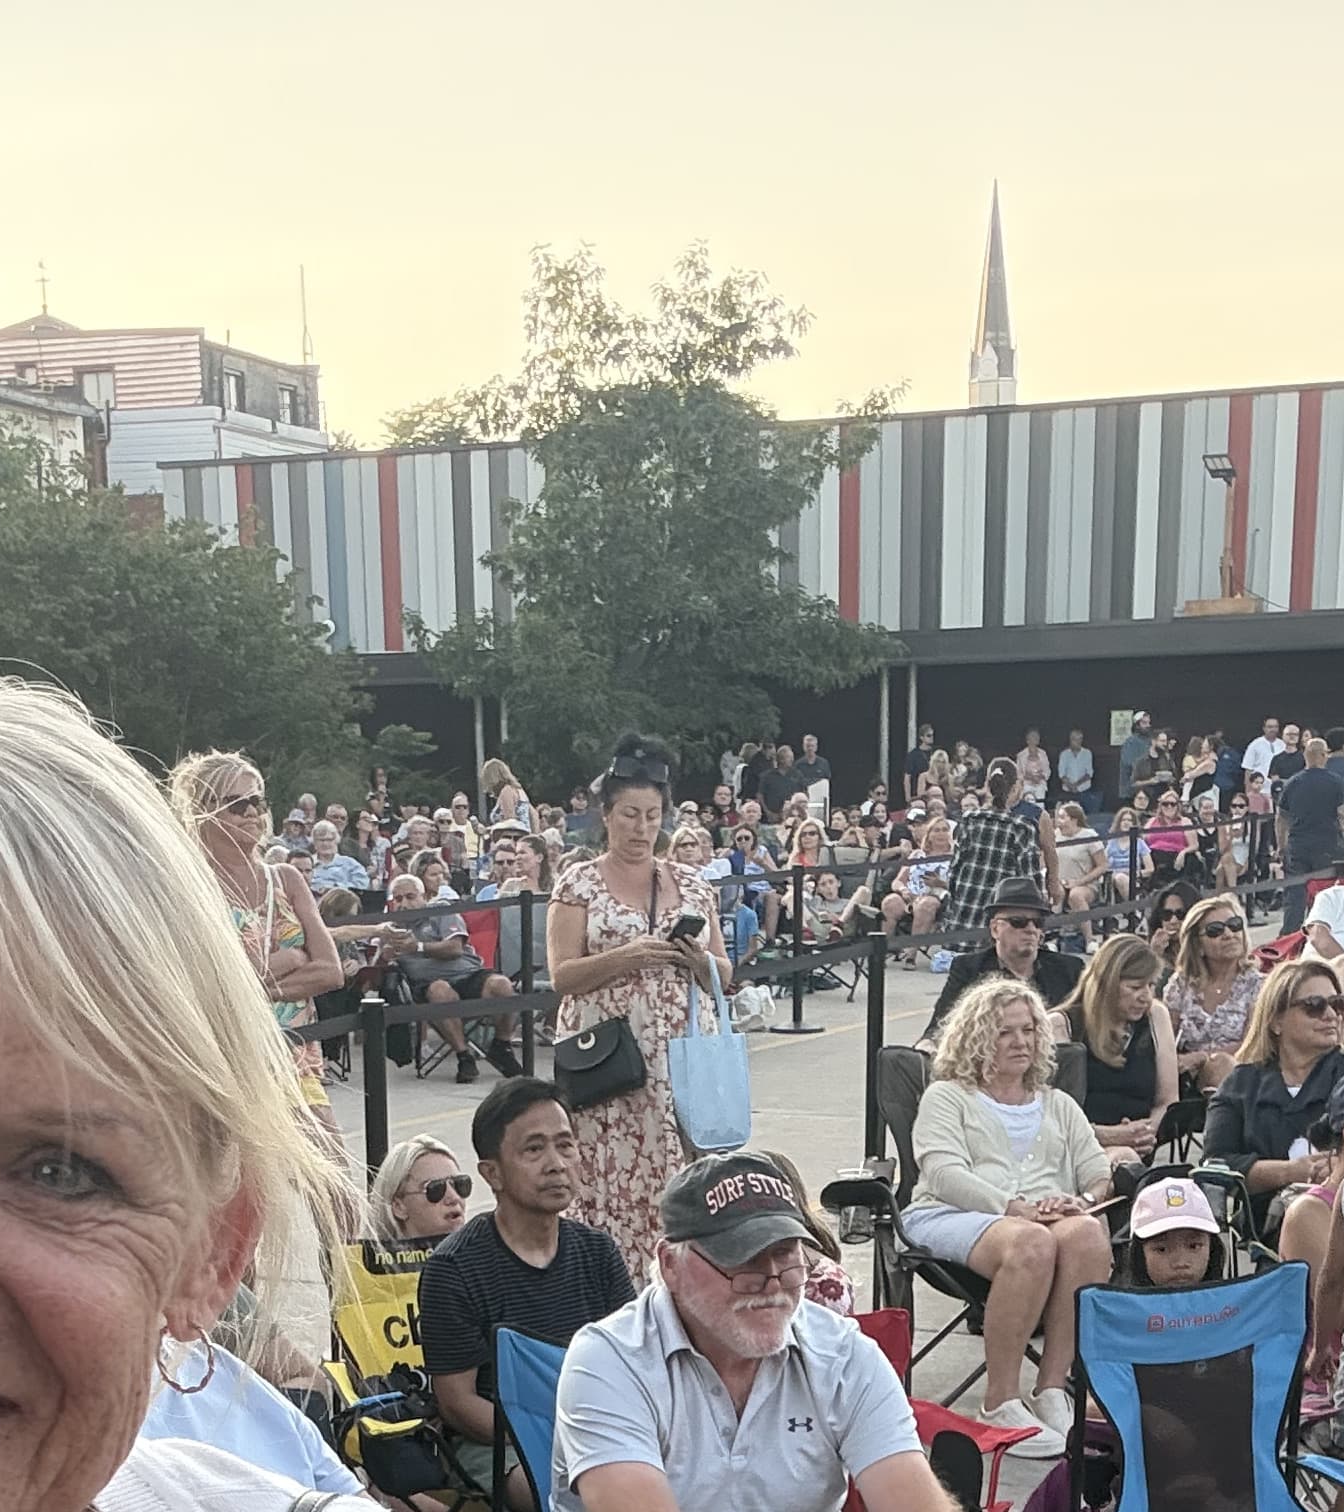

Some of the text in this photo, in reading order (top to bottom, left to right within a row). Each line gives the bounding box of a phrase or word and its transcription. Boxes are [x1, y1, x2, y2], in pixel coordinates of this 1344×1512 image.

[705, 1172, 797, 1215] SURF STYLE
[374, 1251, 394, 1265] no
